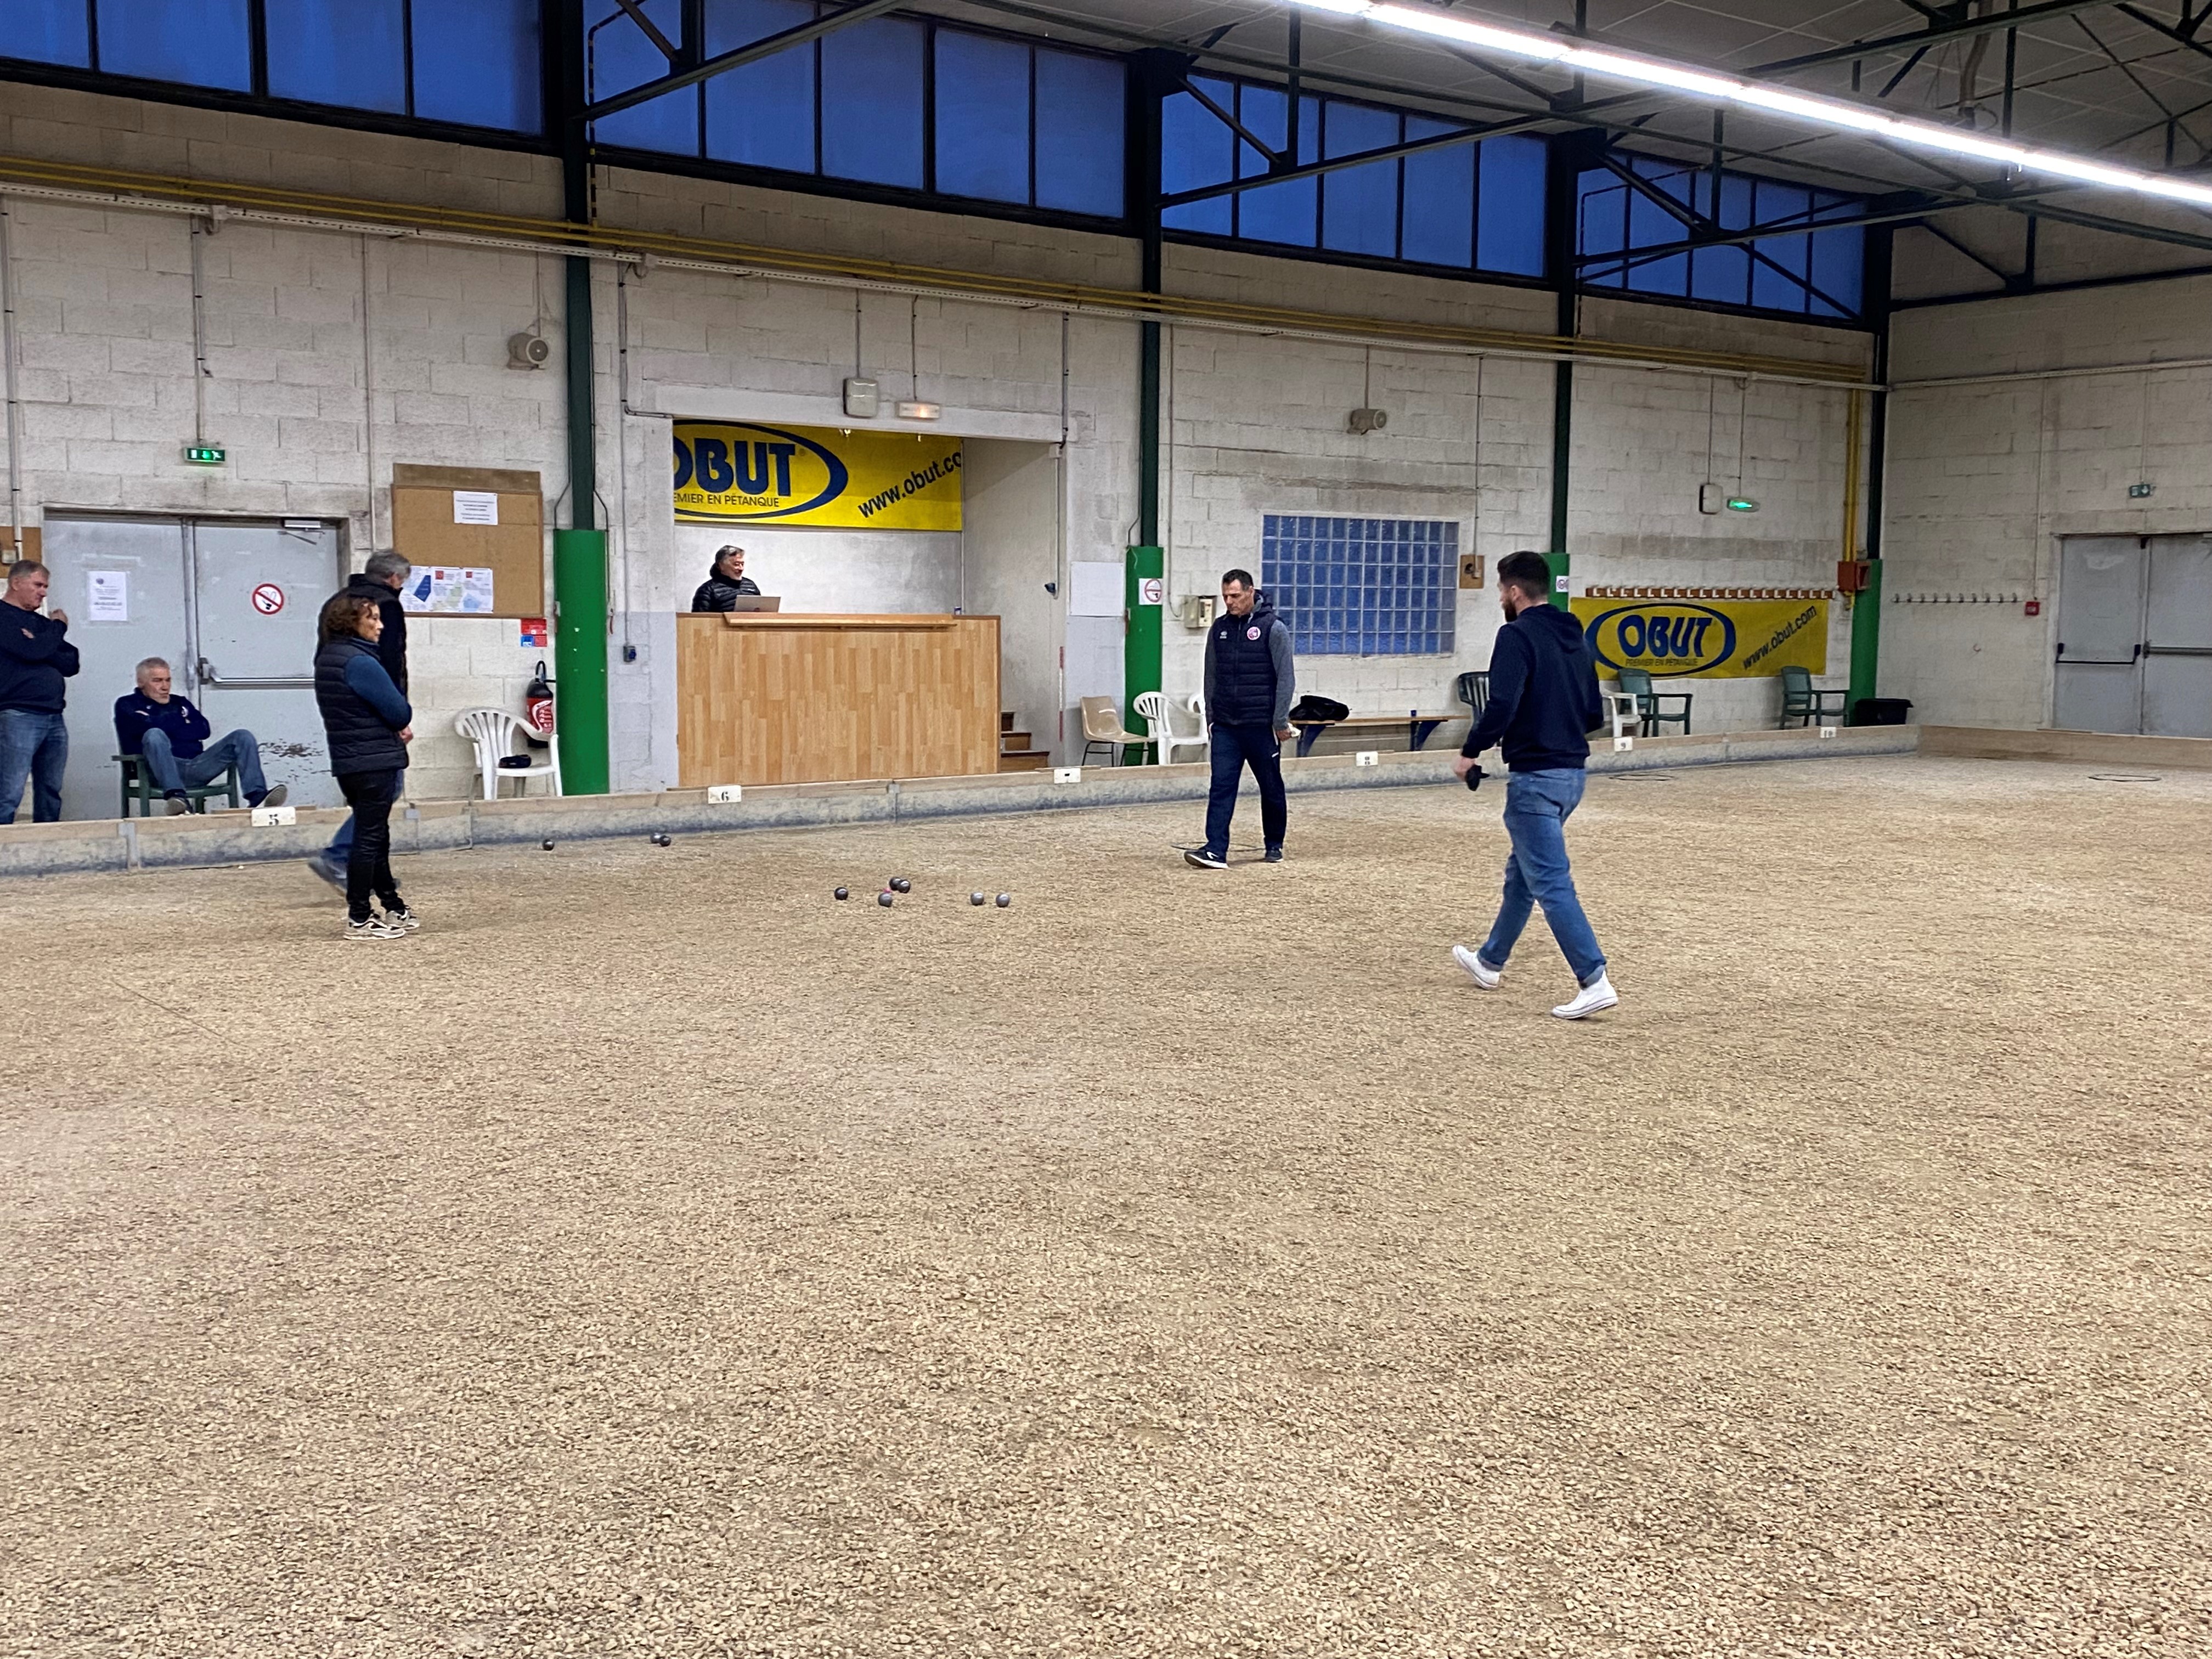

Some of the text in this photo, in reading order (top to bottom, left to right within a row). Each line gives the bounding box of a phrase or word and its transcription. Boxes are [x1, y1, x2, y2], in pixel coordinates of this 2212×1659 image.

[707, 494, 722, 505] EN
[1617, 614, 1713, 658] OBUT
[1743, 605, 1817, 670] www.obut.com
[721, 791, 730, 802] 6
[269, 814, 279, 826] 5
